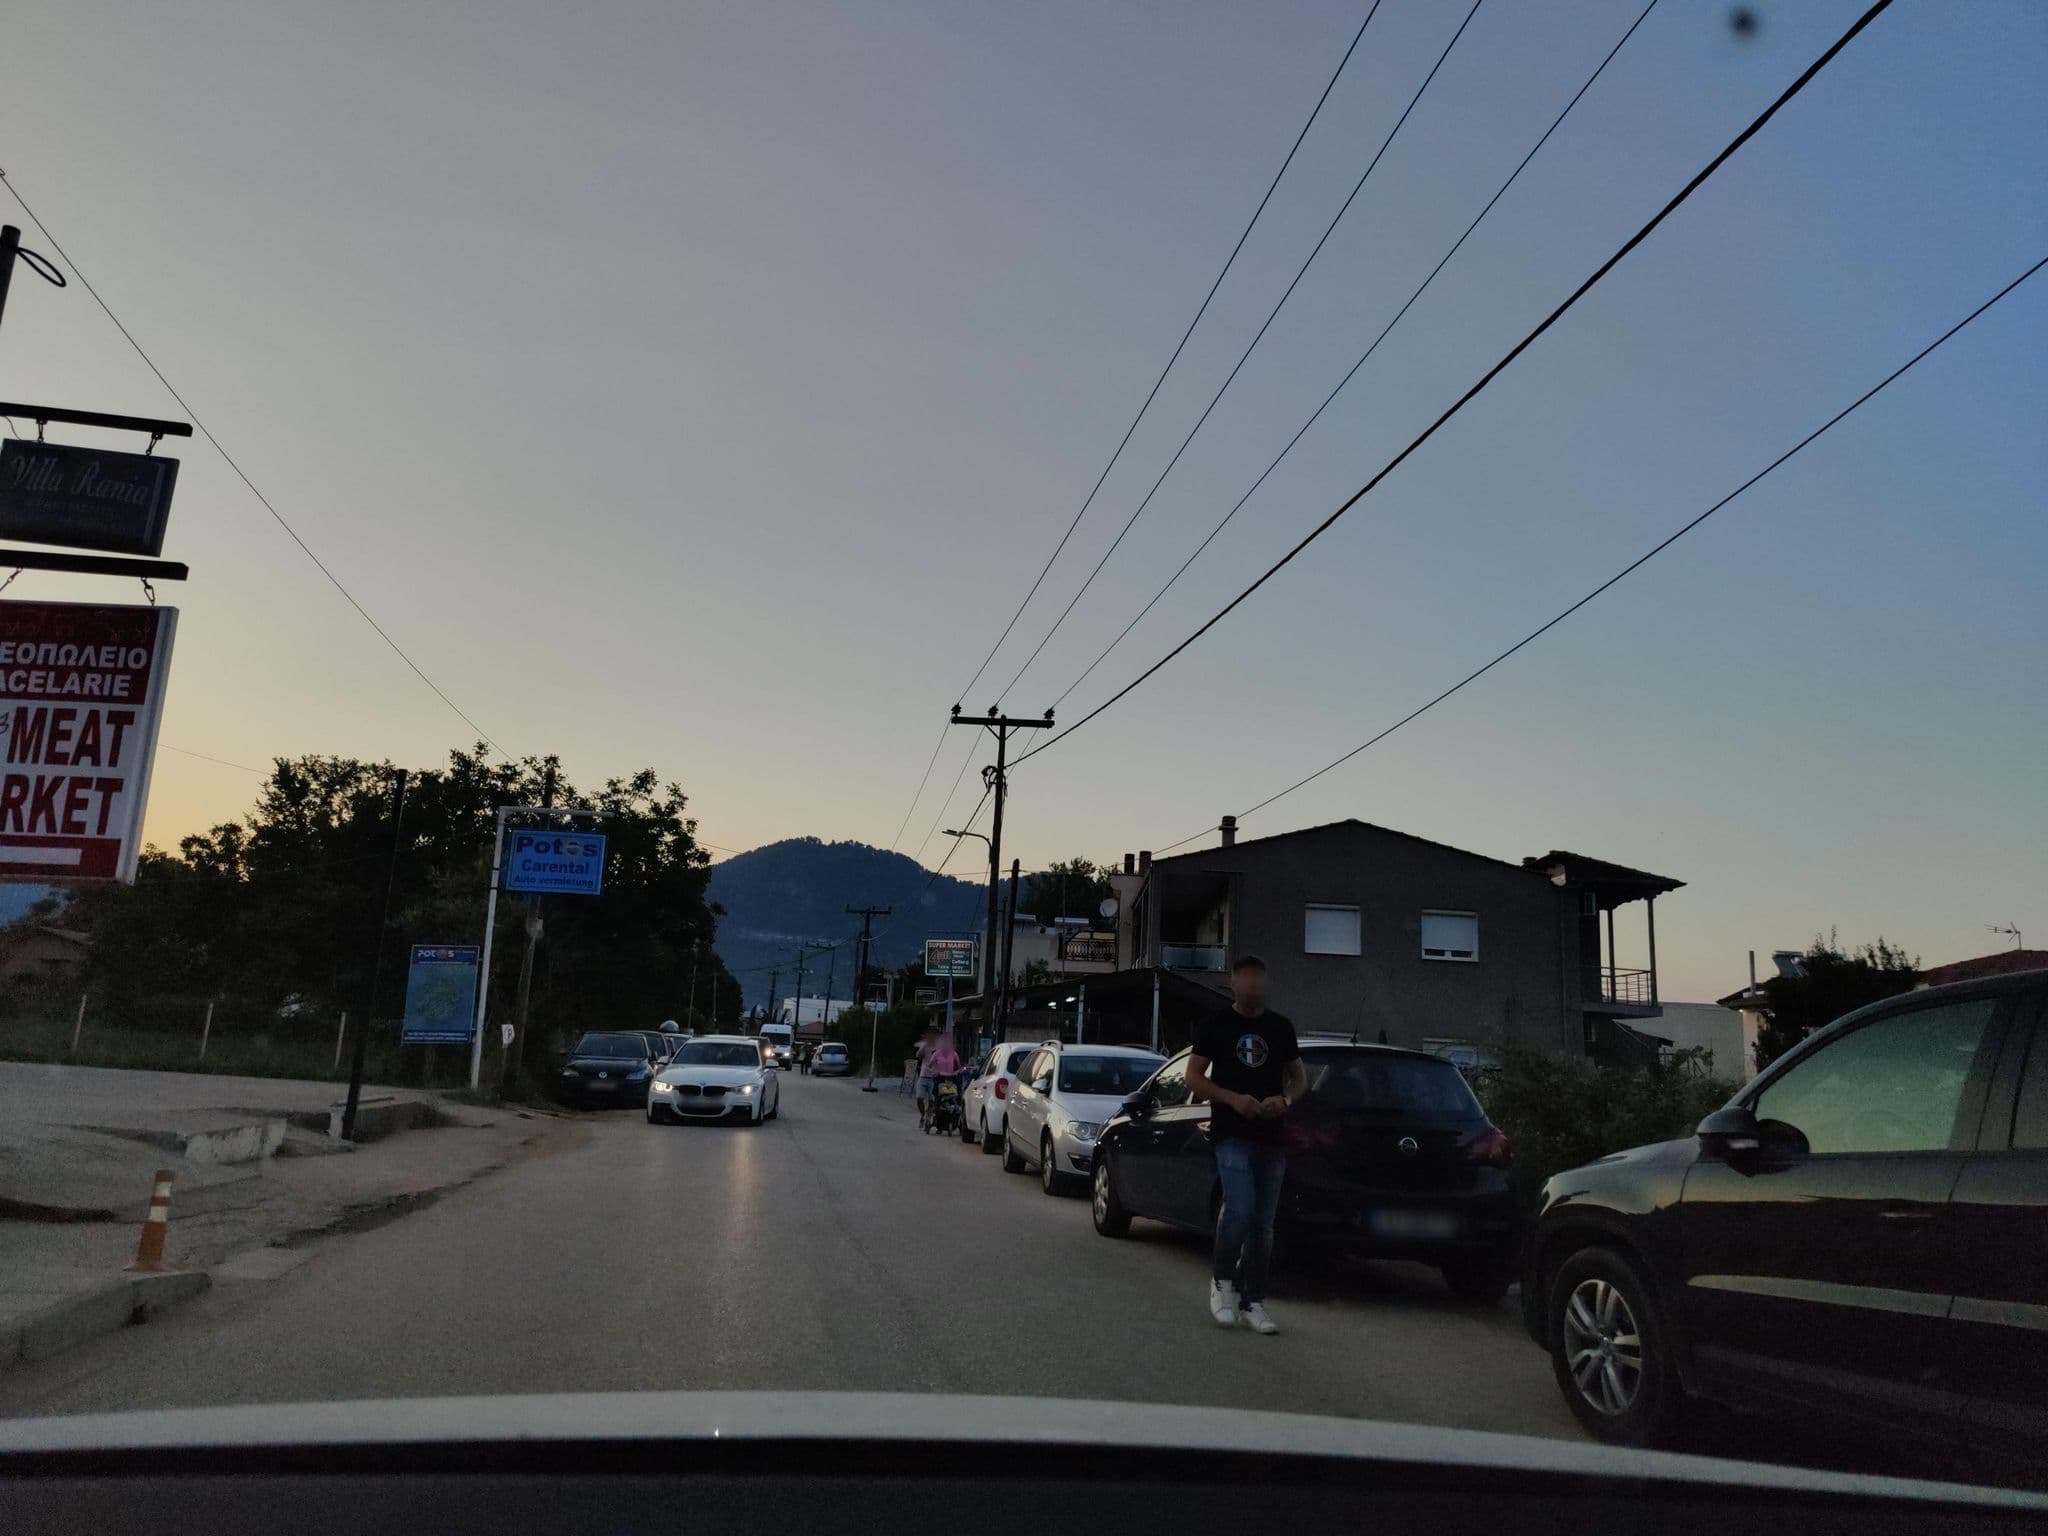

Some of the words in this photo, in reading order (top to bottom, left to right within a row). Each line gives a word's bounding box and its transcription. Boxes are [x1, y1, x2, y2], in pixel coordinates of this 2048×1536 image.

[10, 455, 63, 491] Villa
[0, 670, 131, 697] CELARIE
[7, 706, 136, 768] MEAT
[521, 859, 589, 874] Carental
